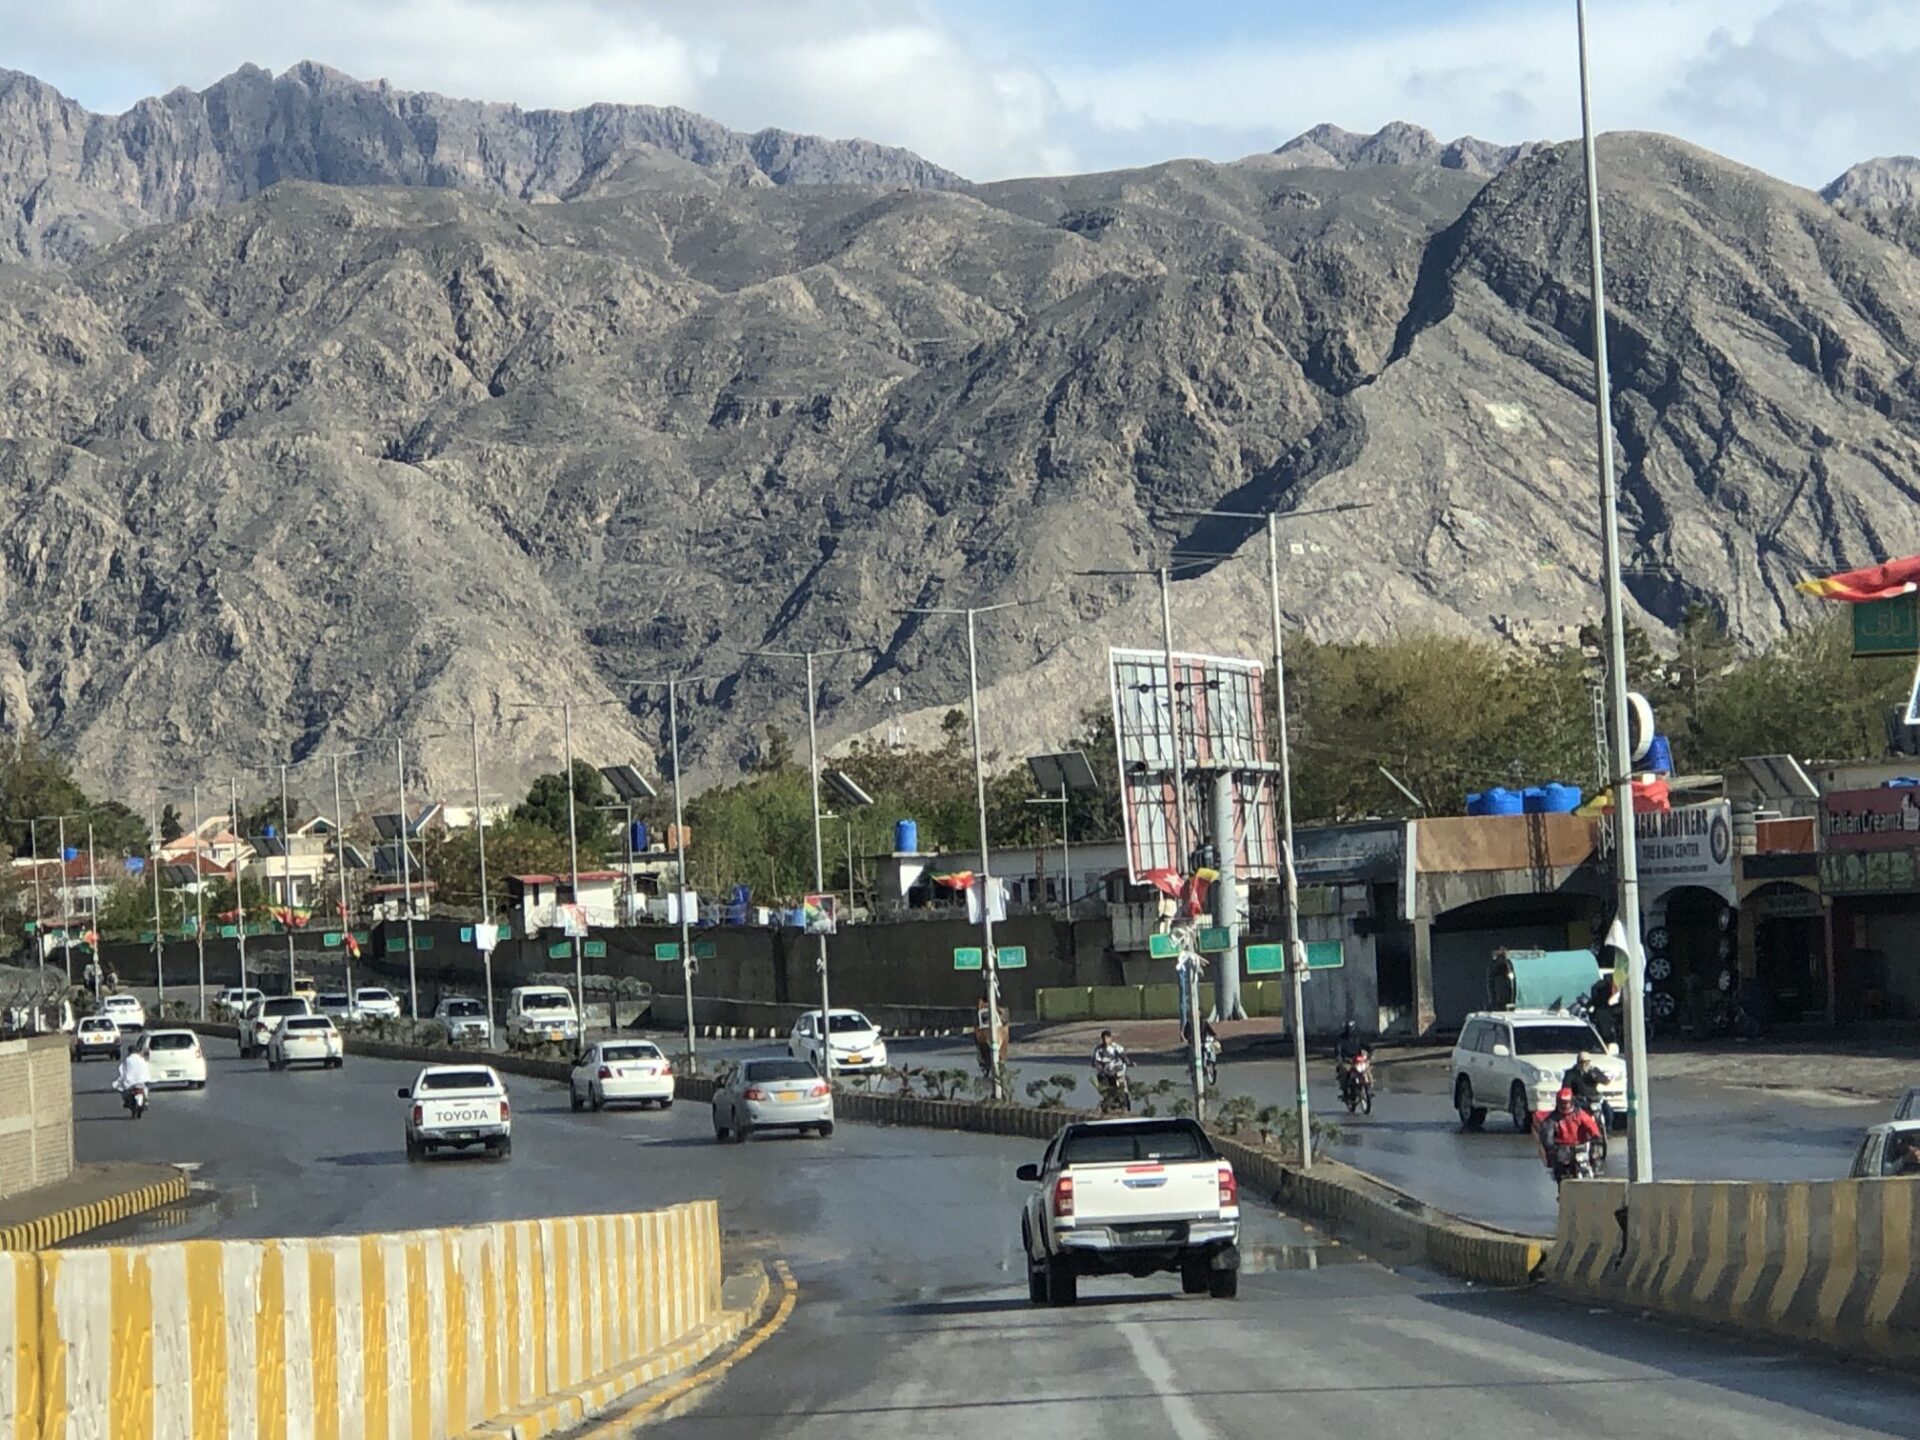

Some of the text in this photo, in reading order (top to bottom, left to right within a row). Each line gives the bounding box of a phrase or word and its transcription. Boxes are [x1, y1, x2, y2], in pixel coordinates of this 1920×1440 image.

[1828, 811, 1861, 836] Italian
[1862, 809, 1902, 833] Creamz
[435, 1110, 489, 1121] TOYOTA
